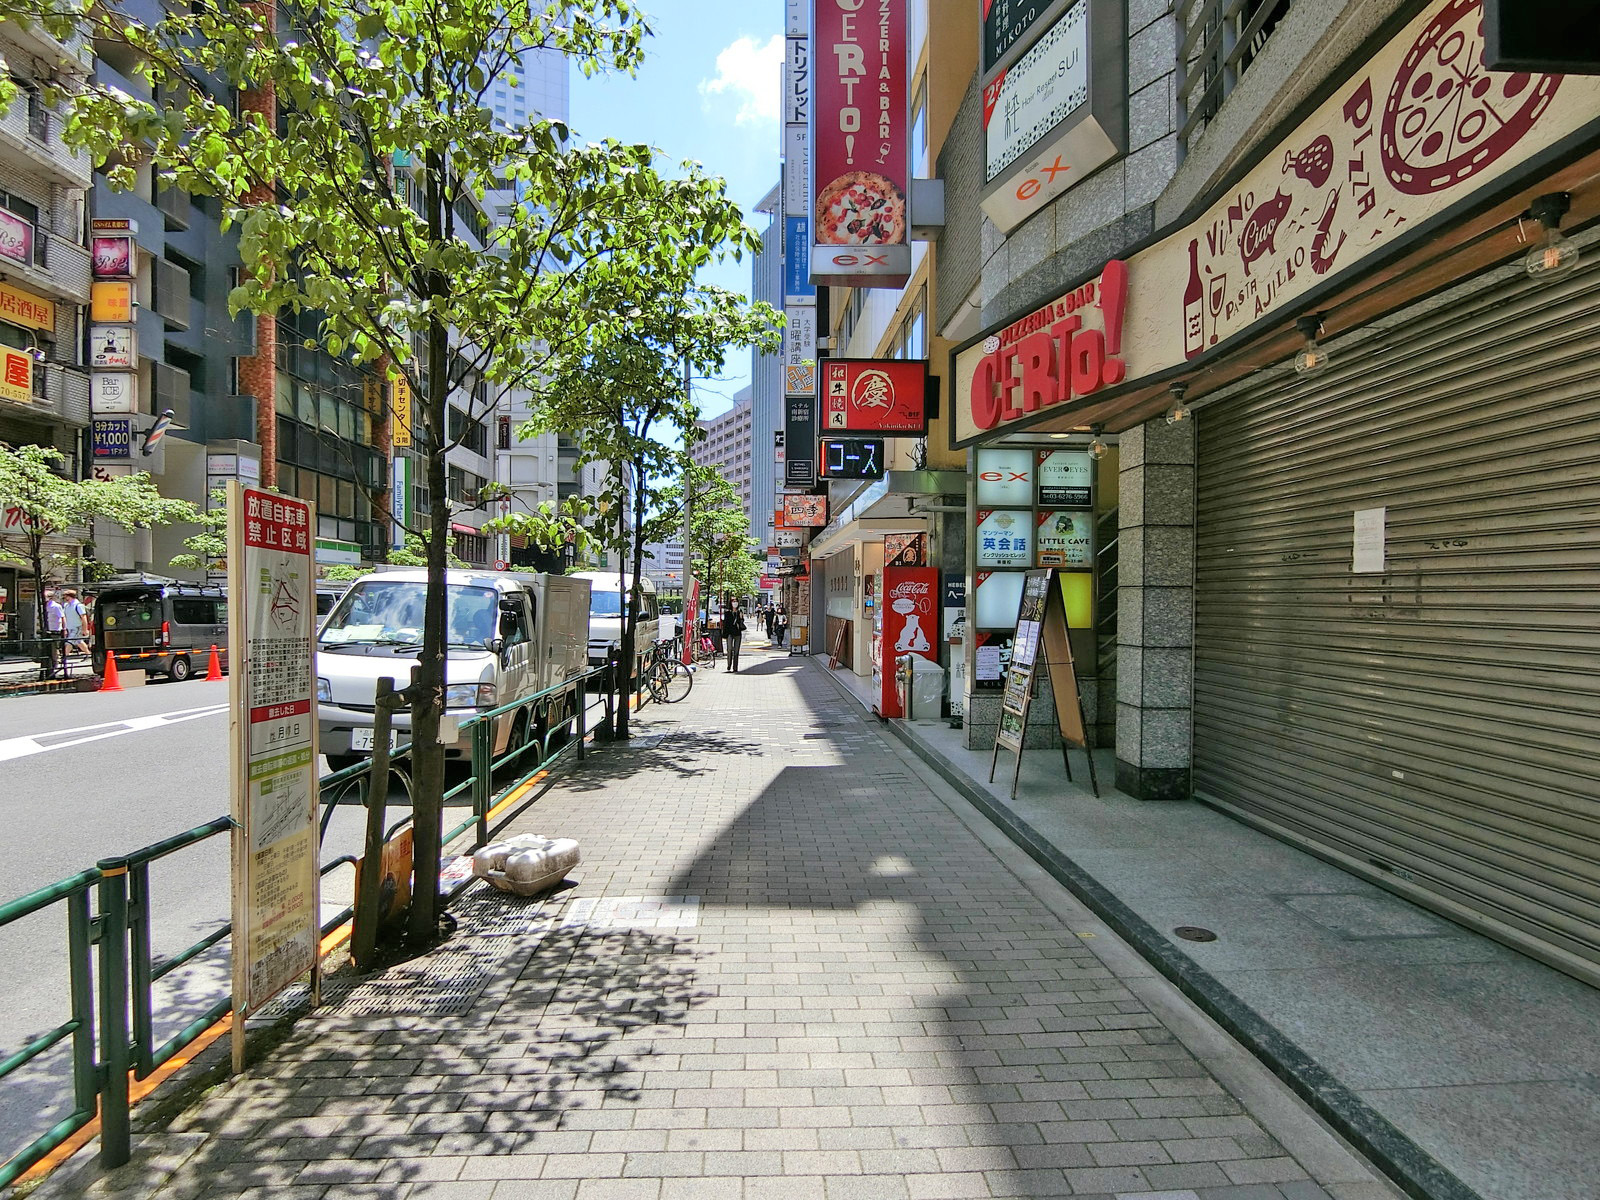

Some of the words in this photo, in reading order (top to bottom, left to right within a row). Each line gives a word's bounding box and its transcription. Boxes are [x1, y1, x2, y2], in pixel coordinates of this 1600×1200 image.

[1058, 47, 1079, 78] SUI
[879, 82, 890, 93] &
[986, 79, 1001, 109] 2F
[878, 96, 891, 139] BAR
[796, 133, 807, 141] 5F
[1342, 75, 1377, 220] PIZZA
[1015, 153, 1072, 201] ex
[1243, 217, 1279, 258] Ciao
[832, 254, 889, 266] ex
[1224, 279, 1258, 321] PASTA
[1253, 246, 1305, 320] AJILLO
[0, 291, 49, 326] 居酒屋
[1001, 304, 1055, 347] PIZZERIA
[1055, 303, 1066, 318] &
[1066, 283, 1096, 314] BAR
[790, 318, 802, 365] 日曜講座
[970, 259, 1129, 430] CERTO!
[4, 352, 30, 390] 屋
[101, 377, 119, 385] Bar
[101, 386, 120, 396] ICE
[831, 366, 846, 427] 和牛焼肉
[857, 375, 890, 409] 慶
[94, 421, 127, 431] 9分カット
[94, 432, 129, 448] ¥1,000
[979, 471, 1029, 482] ex
[247, 495, 307, 528] 放置自転車
[395, 480, 404, 521] FamilyMart
[247, 520, 307, 551] 禁止区域
[982, 537, 1026, 551] 英会話
